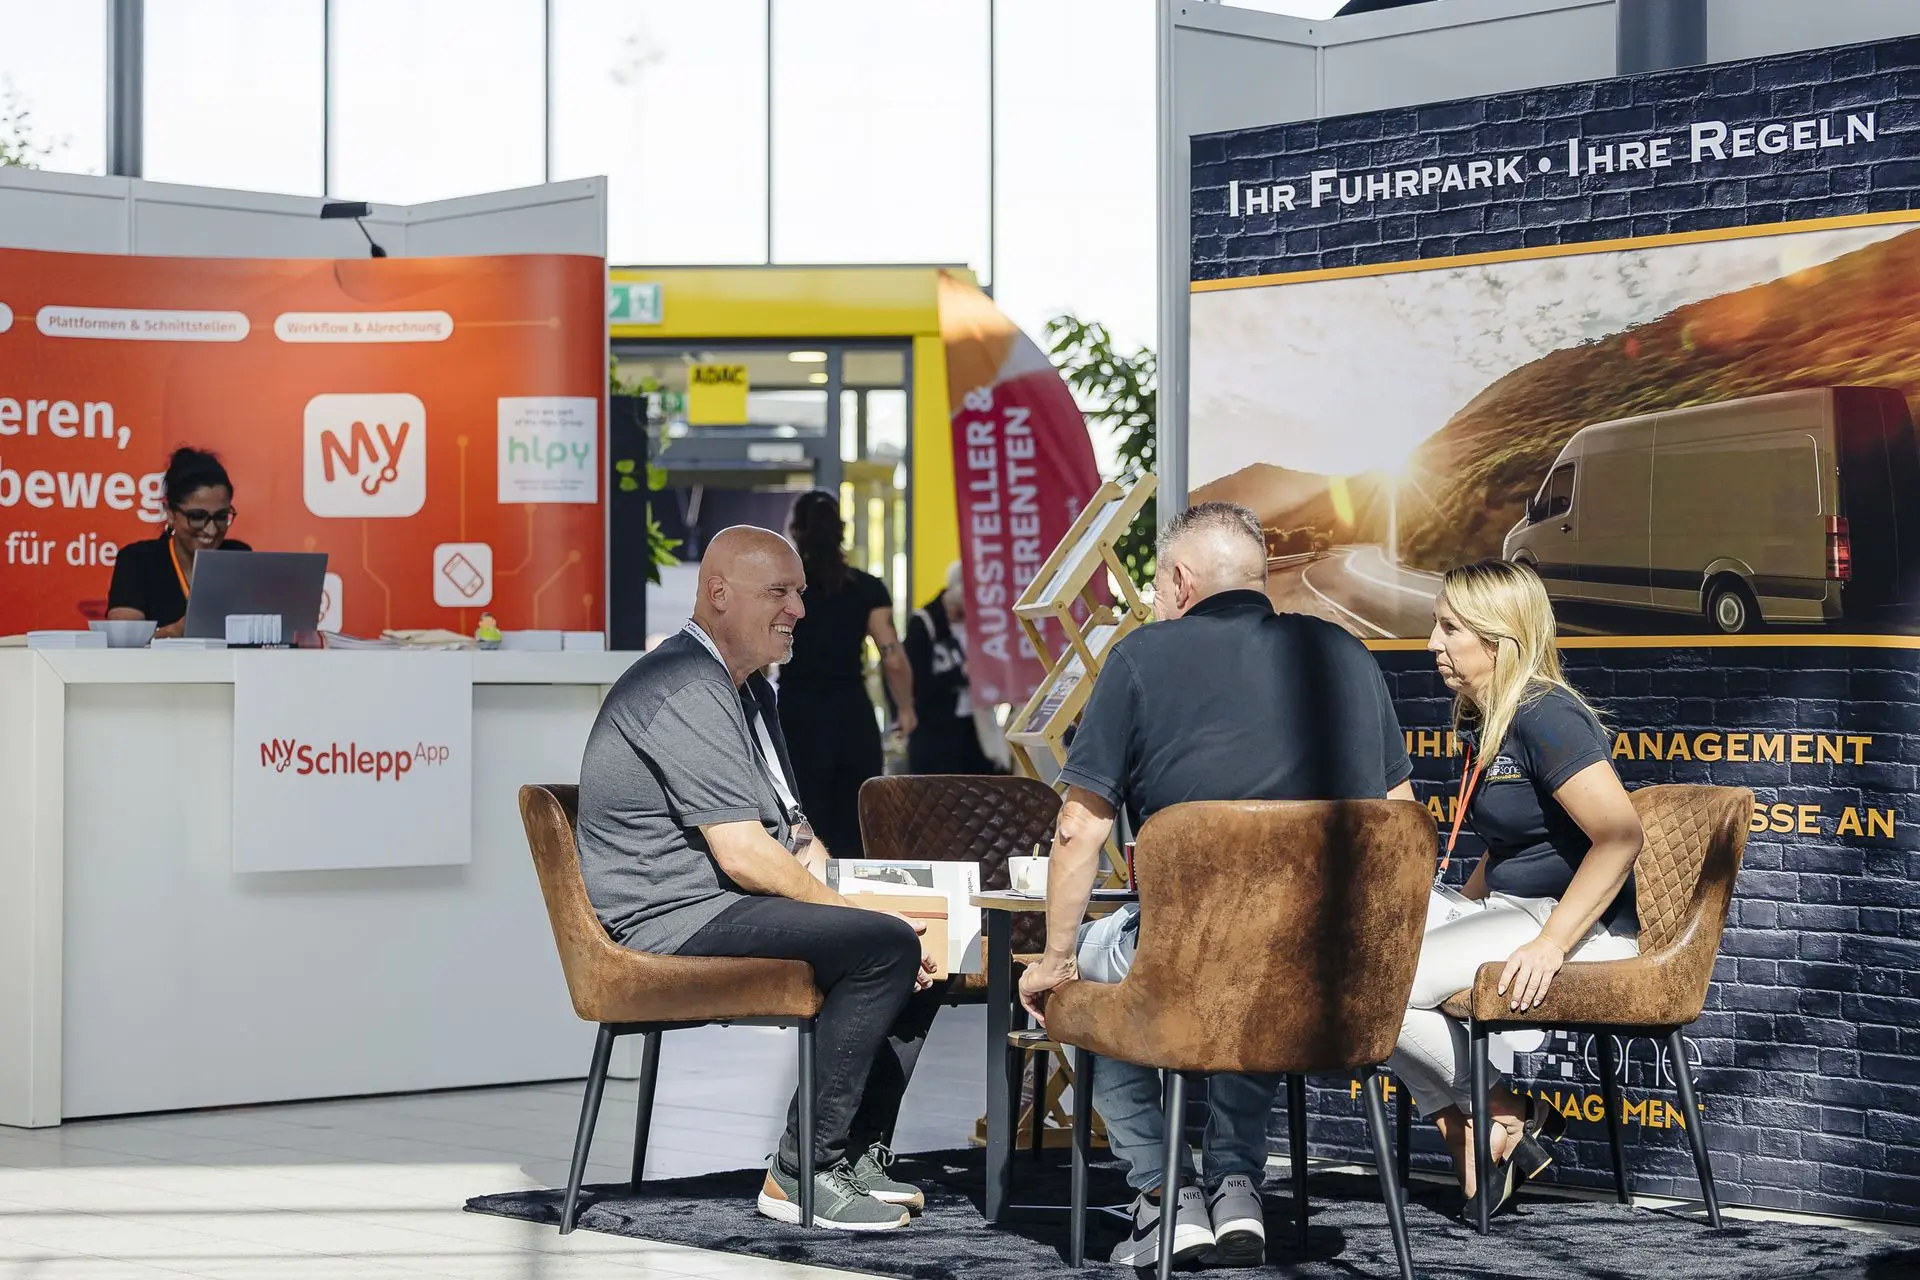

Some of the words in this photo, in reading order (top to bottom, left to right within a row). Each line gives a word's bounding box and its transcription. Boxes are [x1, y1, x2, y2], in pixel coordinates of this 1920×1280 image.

[48, 315, 126, 331] Plattformen
[130, 319, 140, 332] &
[144, 319, 237, 334] Schnittstellen
[287, 321, 349, 335] Workflow
[353, 322, 363, 334] &
[366, 320, 442, 336] Abrechnung
[963, 387, 993, 412] &
[0, 397, 131, 449] eren,
[508, 435, 589, 471] hlpy
[6, 531, 56, 565] für
[66, 532, 118, 567] die
[966, 420, 1010, 660] AUSSTELLER
[1003, 406, 1046, 659] RERENTEN
[1836, 806, 1896, 839] AN
[1183, 1191, 1202, 1201] NIKE
[1227, 1179, 1247, 1188] NIKE
